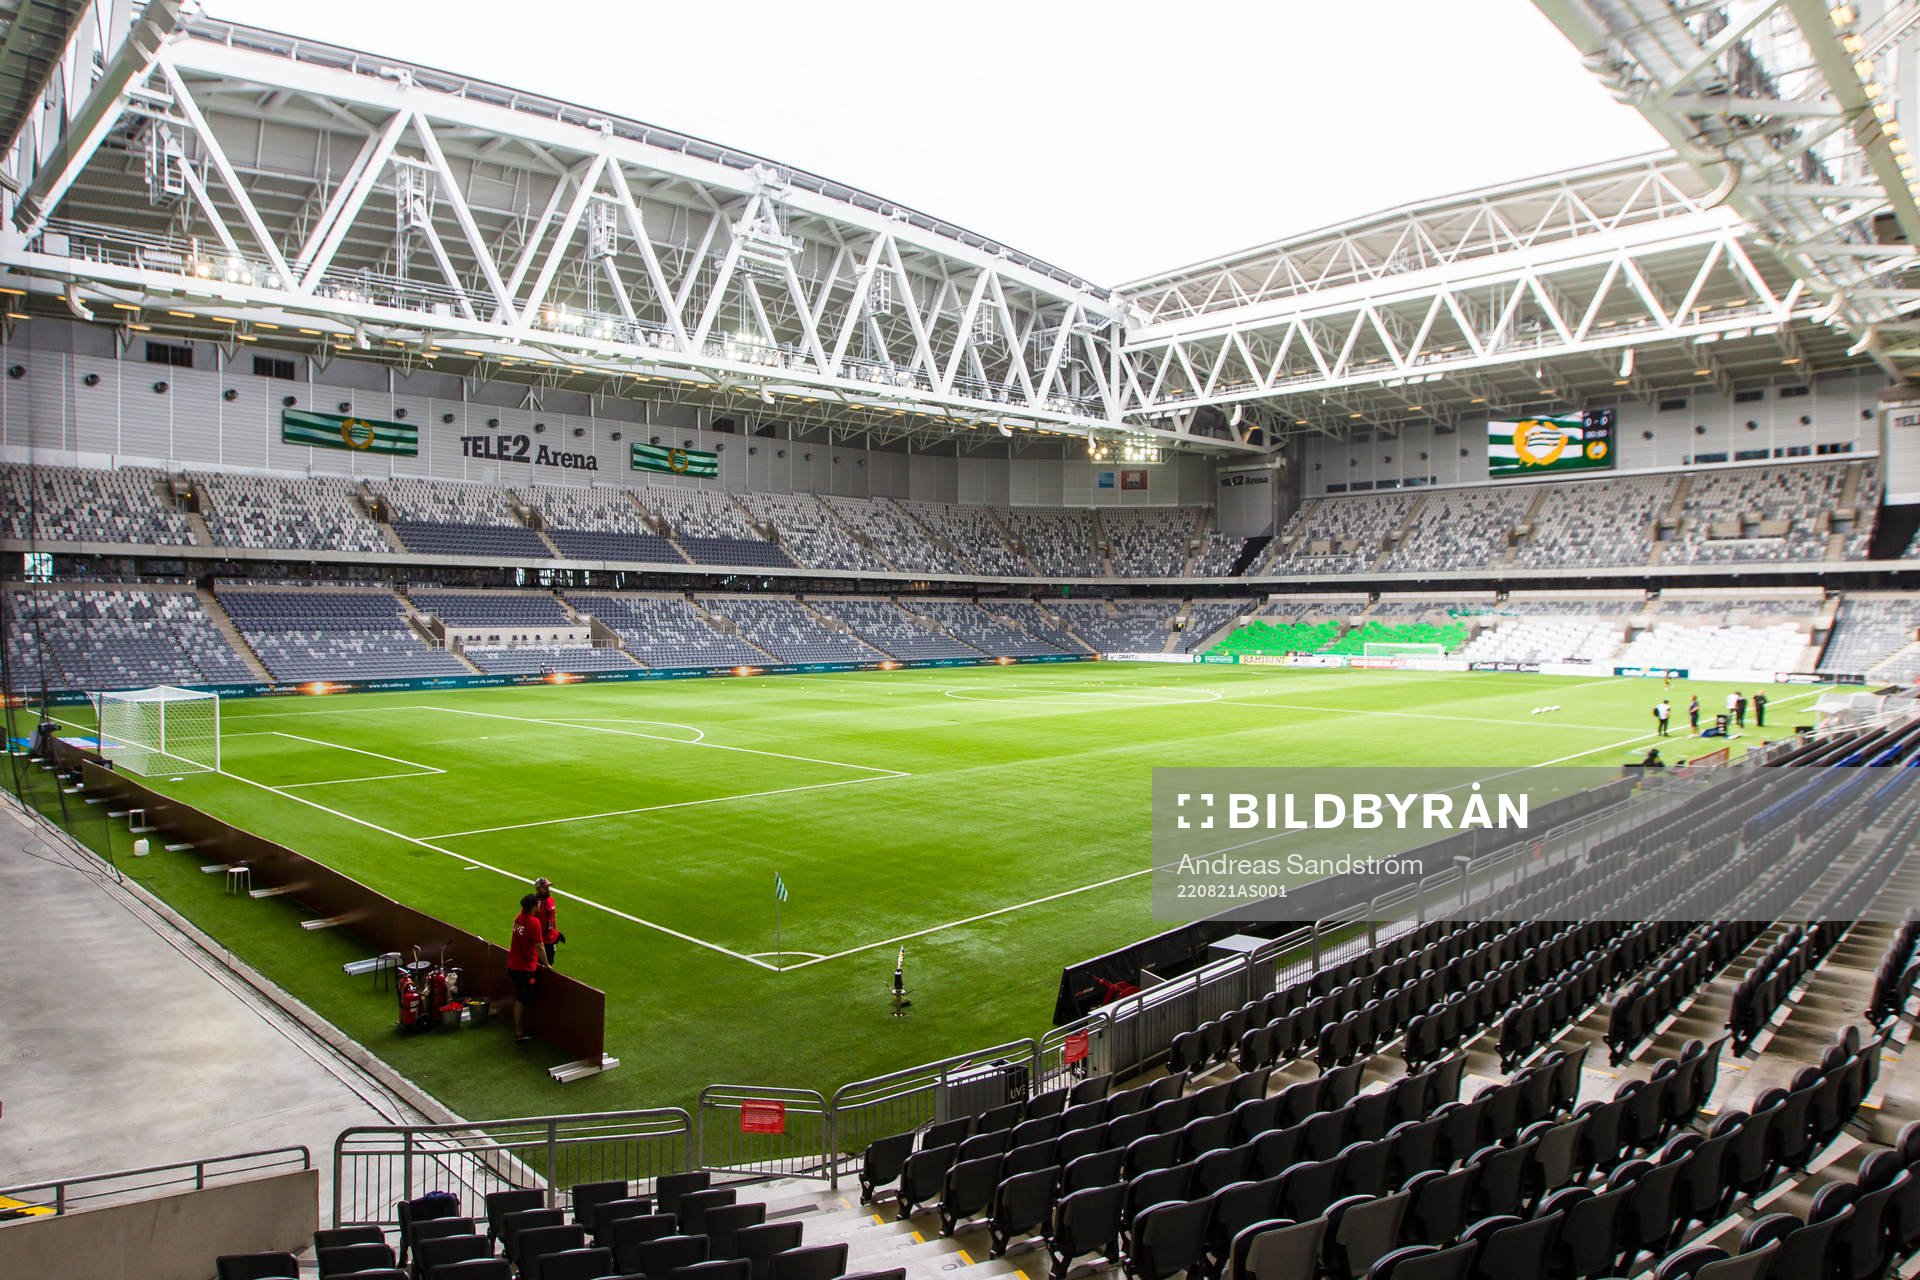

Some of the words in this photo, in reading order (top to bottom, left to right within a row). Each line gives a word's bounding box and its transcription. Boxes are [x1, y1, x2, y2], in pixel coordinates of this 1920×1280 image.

[460, 435, 531, 463] TELE2
[535, 444, 598, 471] Arena
[1243, 655, 1286, 665] RAMIRENT
